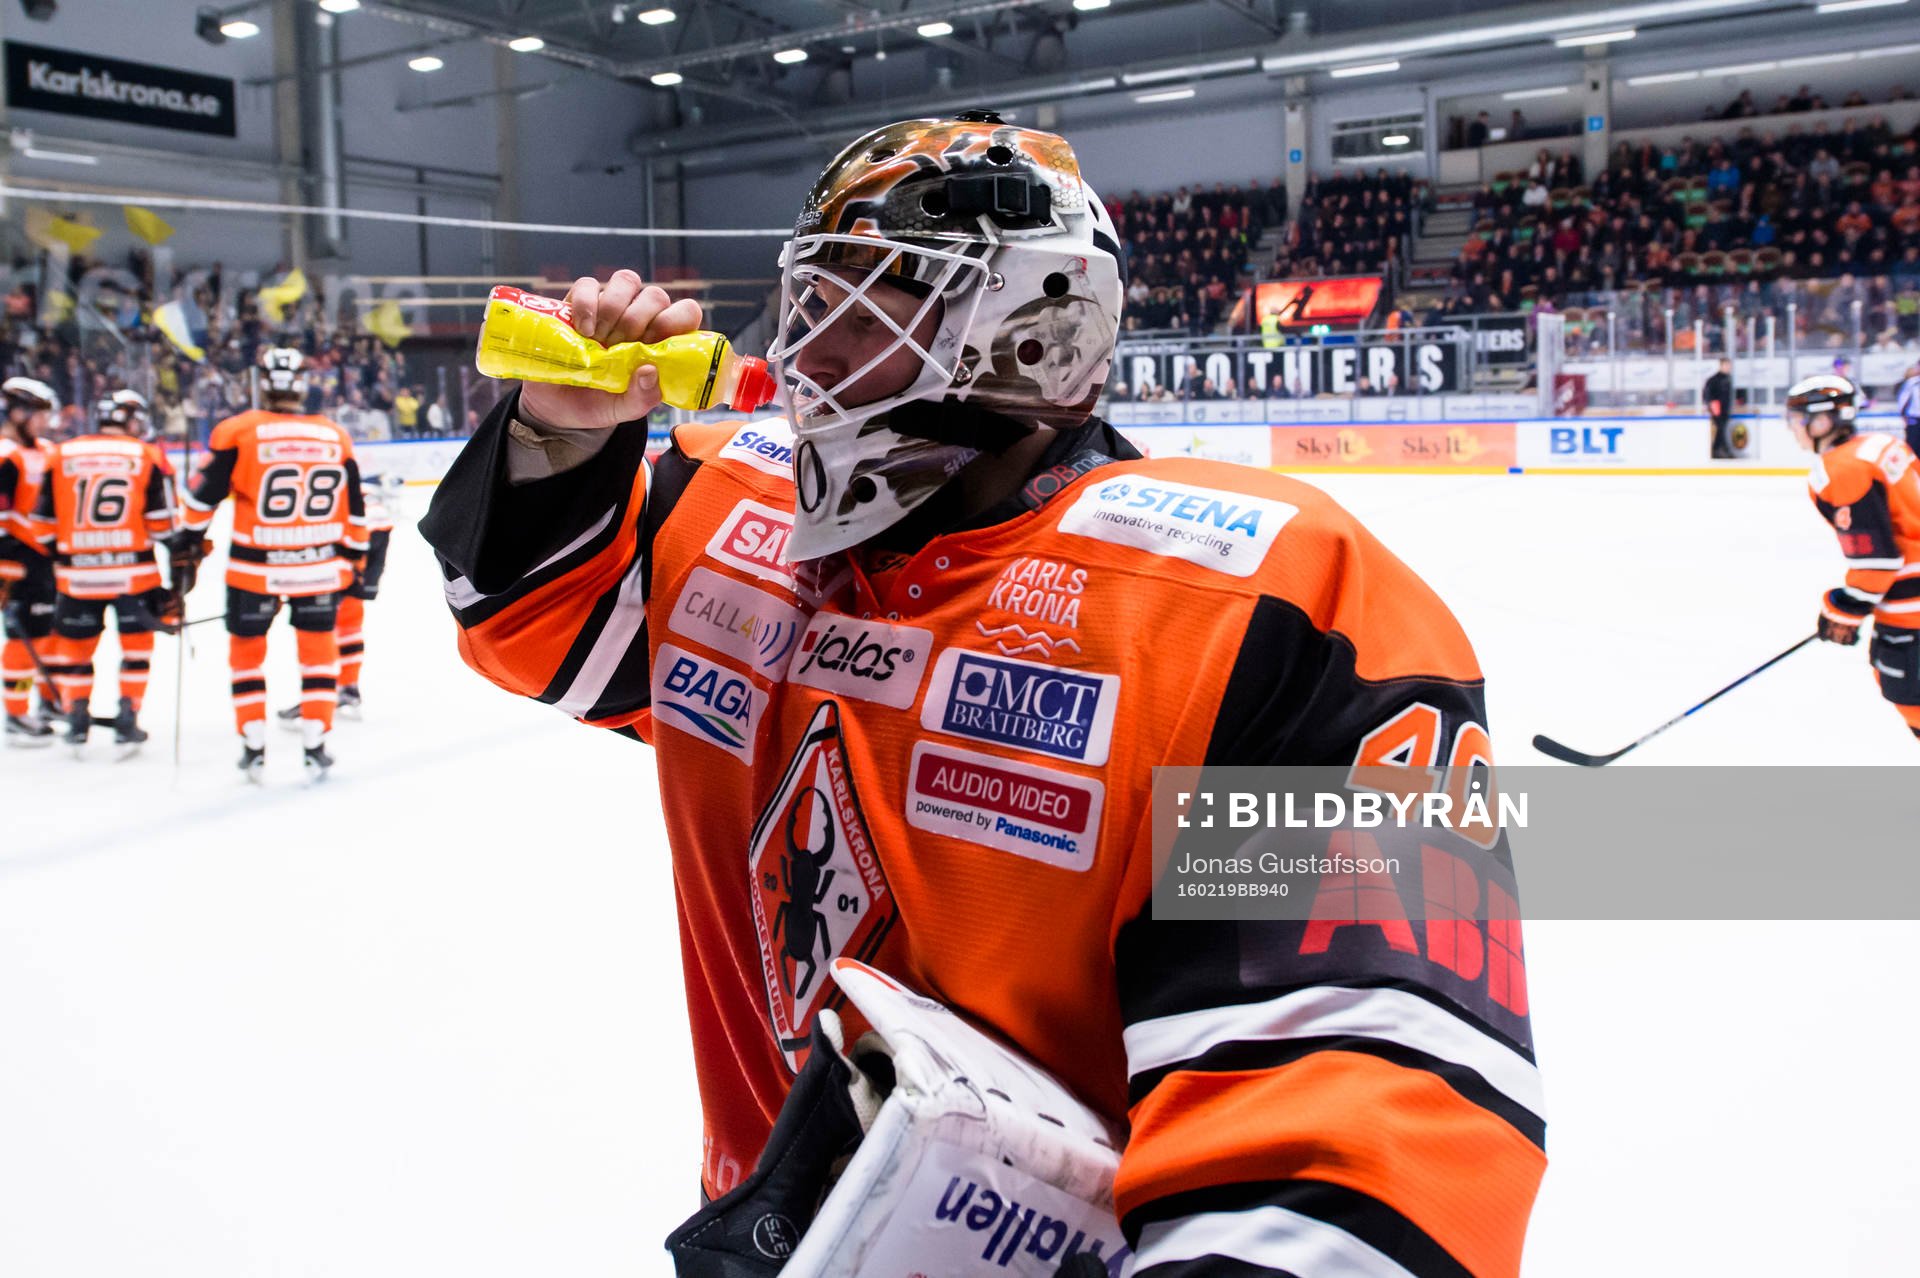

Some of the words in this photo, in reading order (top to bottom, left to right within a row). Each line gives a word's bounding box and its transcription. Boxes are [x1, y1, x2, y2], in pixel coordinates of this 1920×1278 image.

[28, 60, 221, 117] Karlskrona.se
[1296, 437, 1351, 459] Skylt
[1551, 428, 1623, 454] BLT
[75, 476, 131, 527] 16
[258, 466, 344, 521] 68
[1126, 487, 1262, 537] STENA
[1093, 508, 1163, 533] innovative
[1167, 526, 1233, 556] recycling
[1001, 557, 1088, 595] KARLS
[685, 591, 761, 642] CALL4U
[987, 579, 1081, 629] KRONA
[664, 657, 752, 728] BAGA
[991, 670, 1096, 726] MCT
[951, 703, 1084, 750] BRATTBERG
[931, 766, 1003, 802] AUDIO
[1009, 781, 1071, 820] VIDEO
[1345, 702, 1499, 850] 40
[828, 747, 886, 901] KARLSKRONA
[916, 800, 974, 823] powered
[976, 812, 992, 830] by
[995, 816, 1077, 852] Panasonic
[838, 894, 859, 913] 01
[750, 869, 788, 1036] HOCKEYKLUBB
